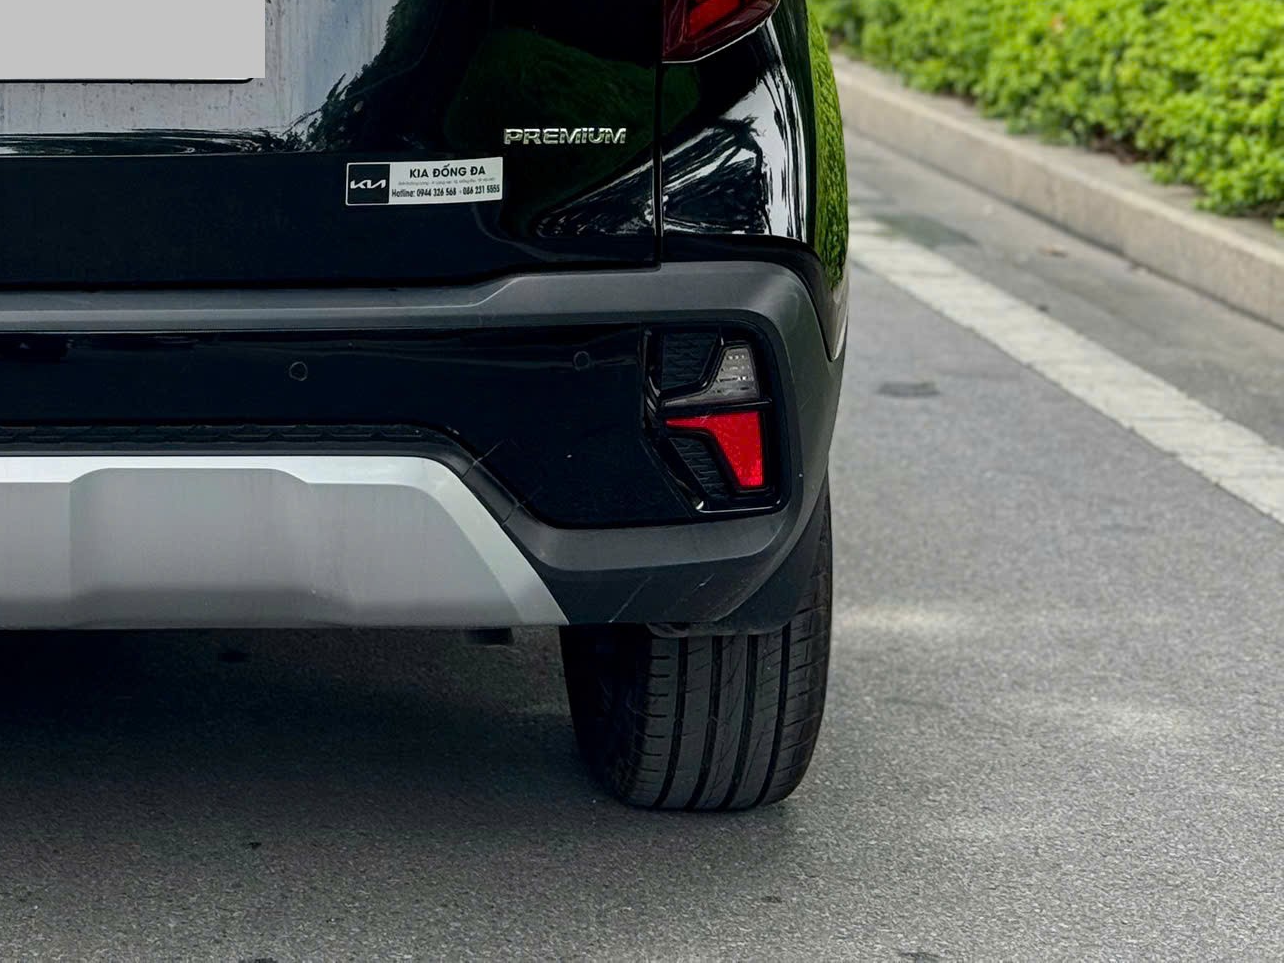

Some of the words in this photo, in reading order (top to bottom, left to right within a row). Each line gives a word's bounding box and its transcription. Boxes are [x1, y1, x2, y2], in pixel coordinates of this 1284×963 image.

[504, 127, 627, 145] PREMIUM
[409, 168, 429, 178] KIA
[432, 163, 467, 177] ĐỐNG
[470, 165, 486, 176] ĐA
[350, 179, 387, 189] KIA
